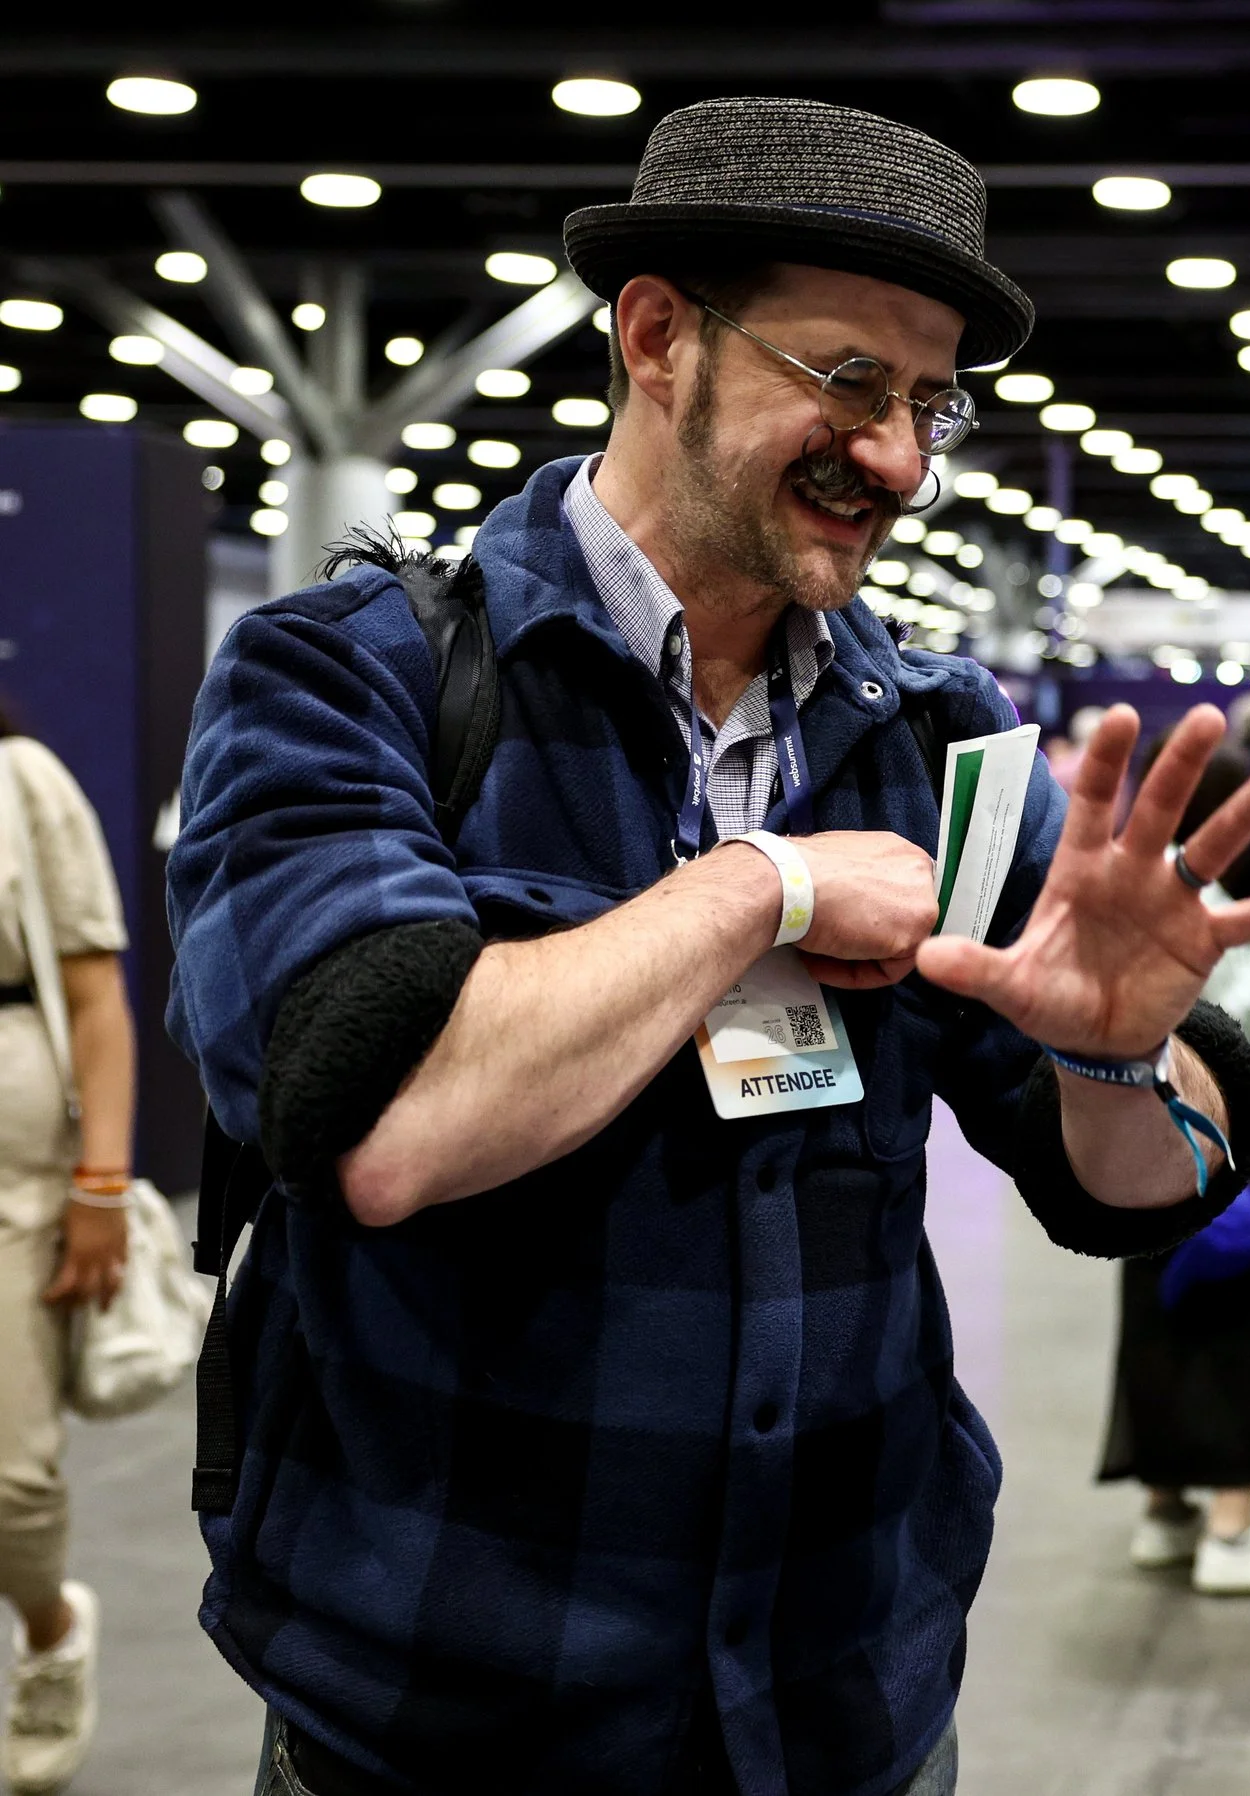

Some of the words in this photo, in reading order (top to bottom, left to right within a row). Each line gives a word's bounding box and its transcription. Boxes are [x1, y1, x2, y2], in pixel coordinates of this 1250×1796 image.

[784, 735, 801, 788] websummit
[691, 767, 702, 806] paybilt
[764, 1024, 787, 1045] 26
[740, 1068, 837, 1098] ATTENDEE
